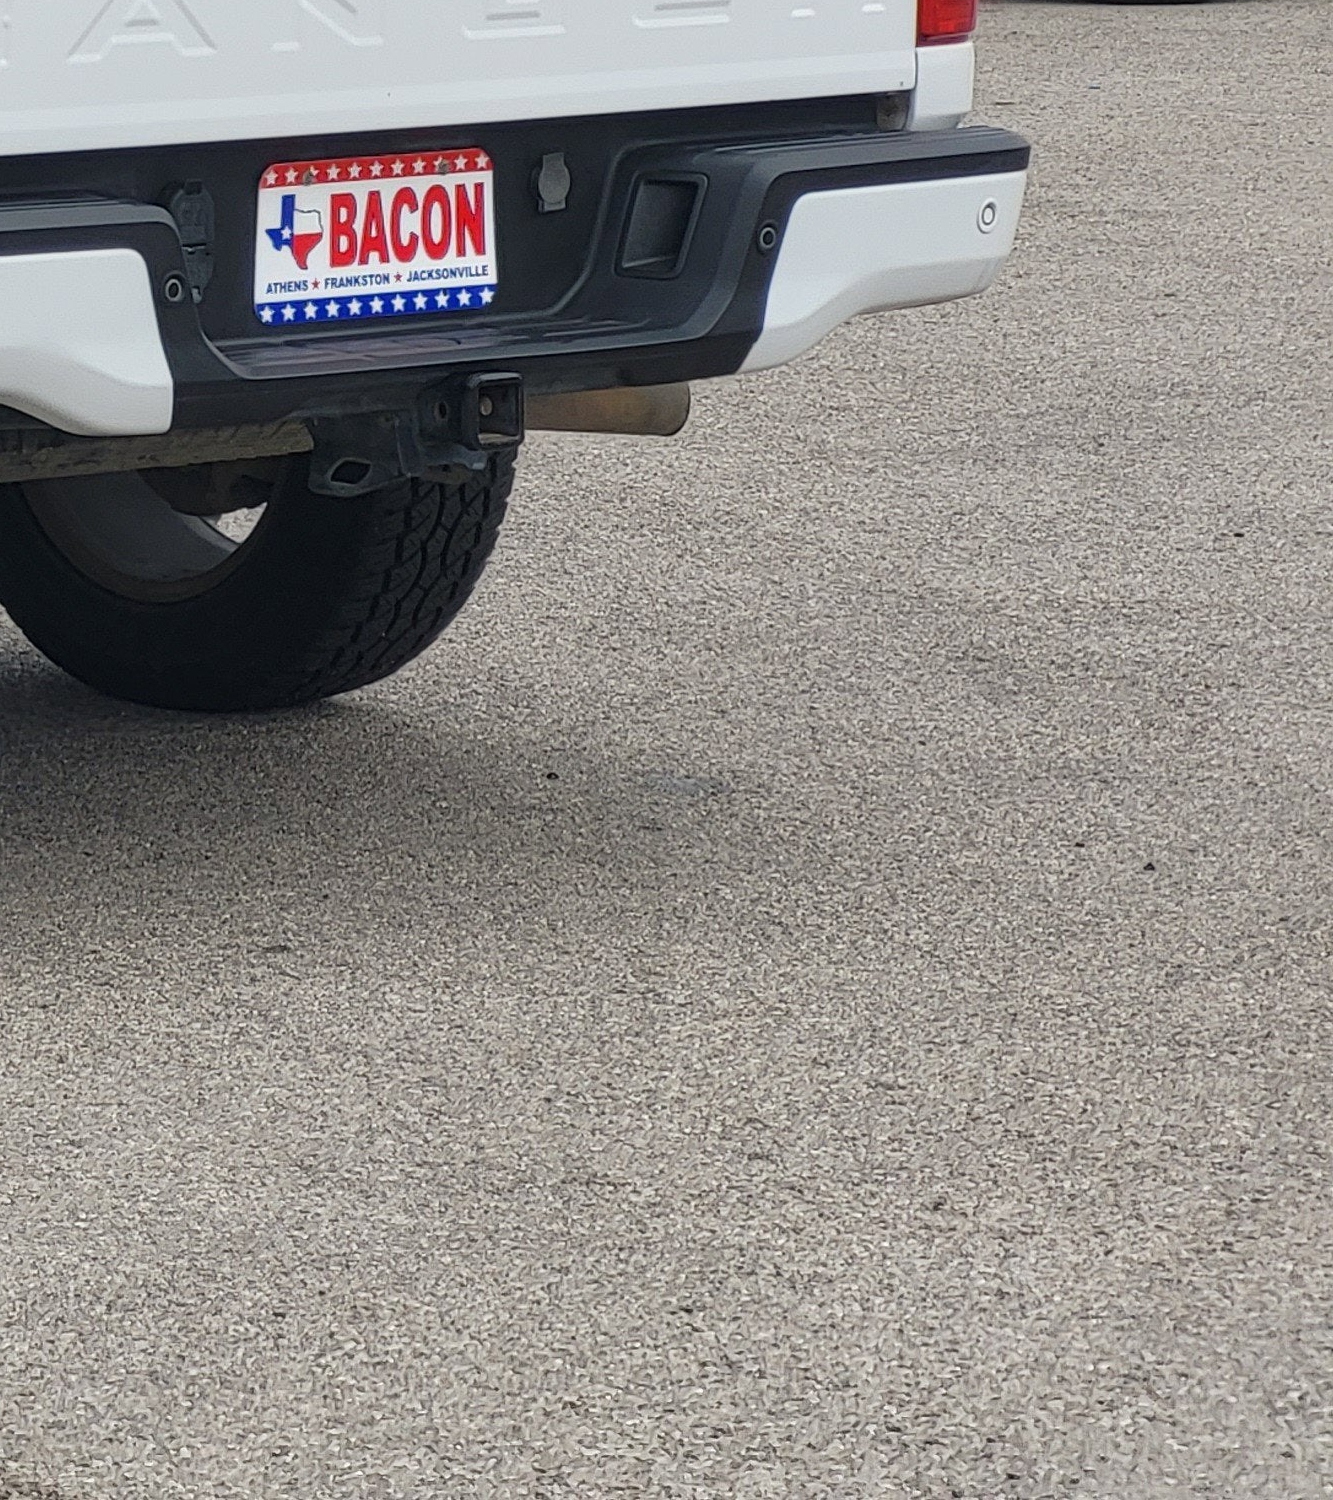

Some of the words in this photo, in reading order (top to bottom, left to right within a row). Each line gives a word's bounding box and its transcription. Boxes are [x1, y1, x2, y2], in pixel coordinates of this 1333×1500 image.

[329, 182, 486, 268] BACON
[265, 277, 309, 295] ATHENS
[324, 272, 391, 290] FRANKSTON
[406, 264, 489, 284] JACKSONVILLE
